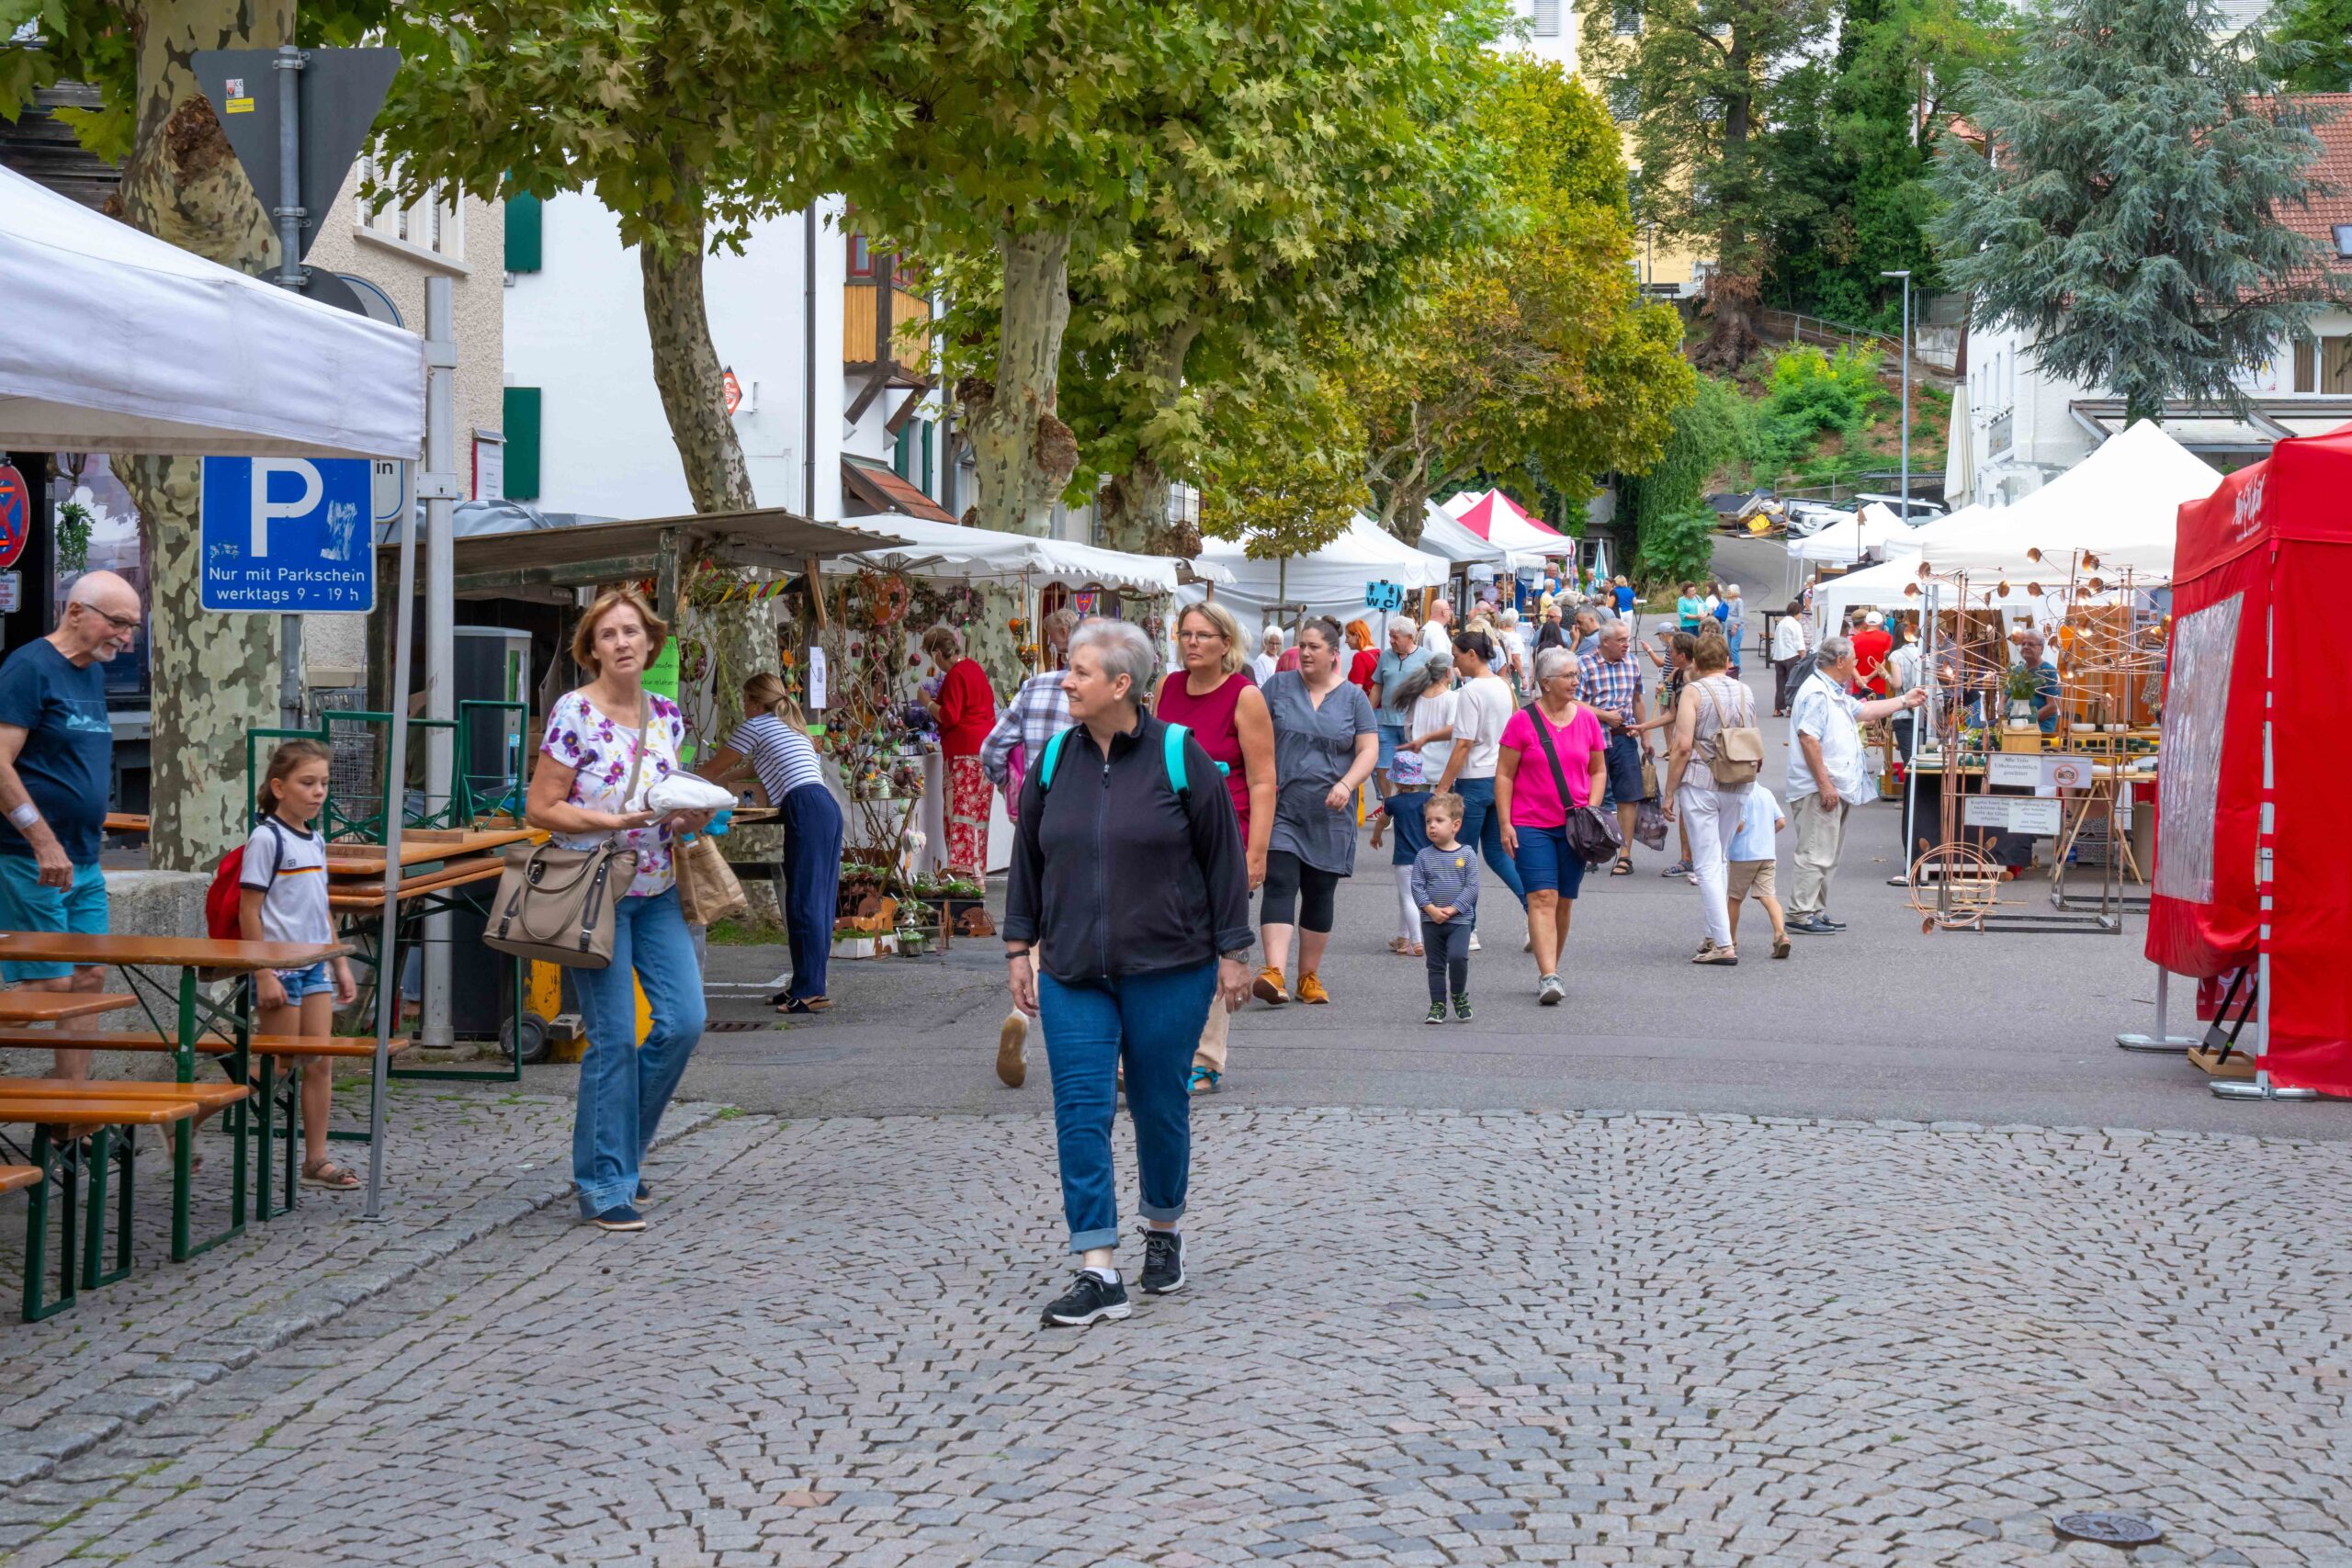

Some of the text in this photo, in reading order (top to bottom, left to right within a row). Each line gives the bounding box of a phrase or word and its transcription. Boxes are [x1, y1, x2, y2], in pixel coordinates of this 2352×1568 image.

[251, 457, 323, 557] P
[209, 567, 365, 581] Nur mit Parkschein
[216, 587, 289, 604] werktags
[297, 588, 306, 601] 9
[327, 588, 343, 601] 19
[349, 588, 359, 601] h
